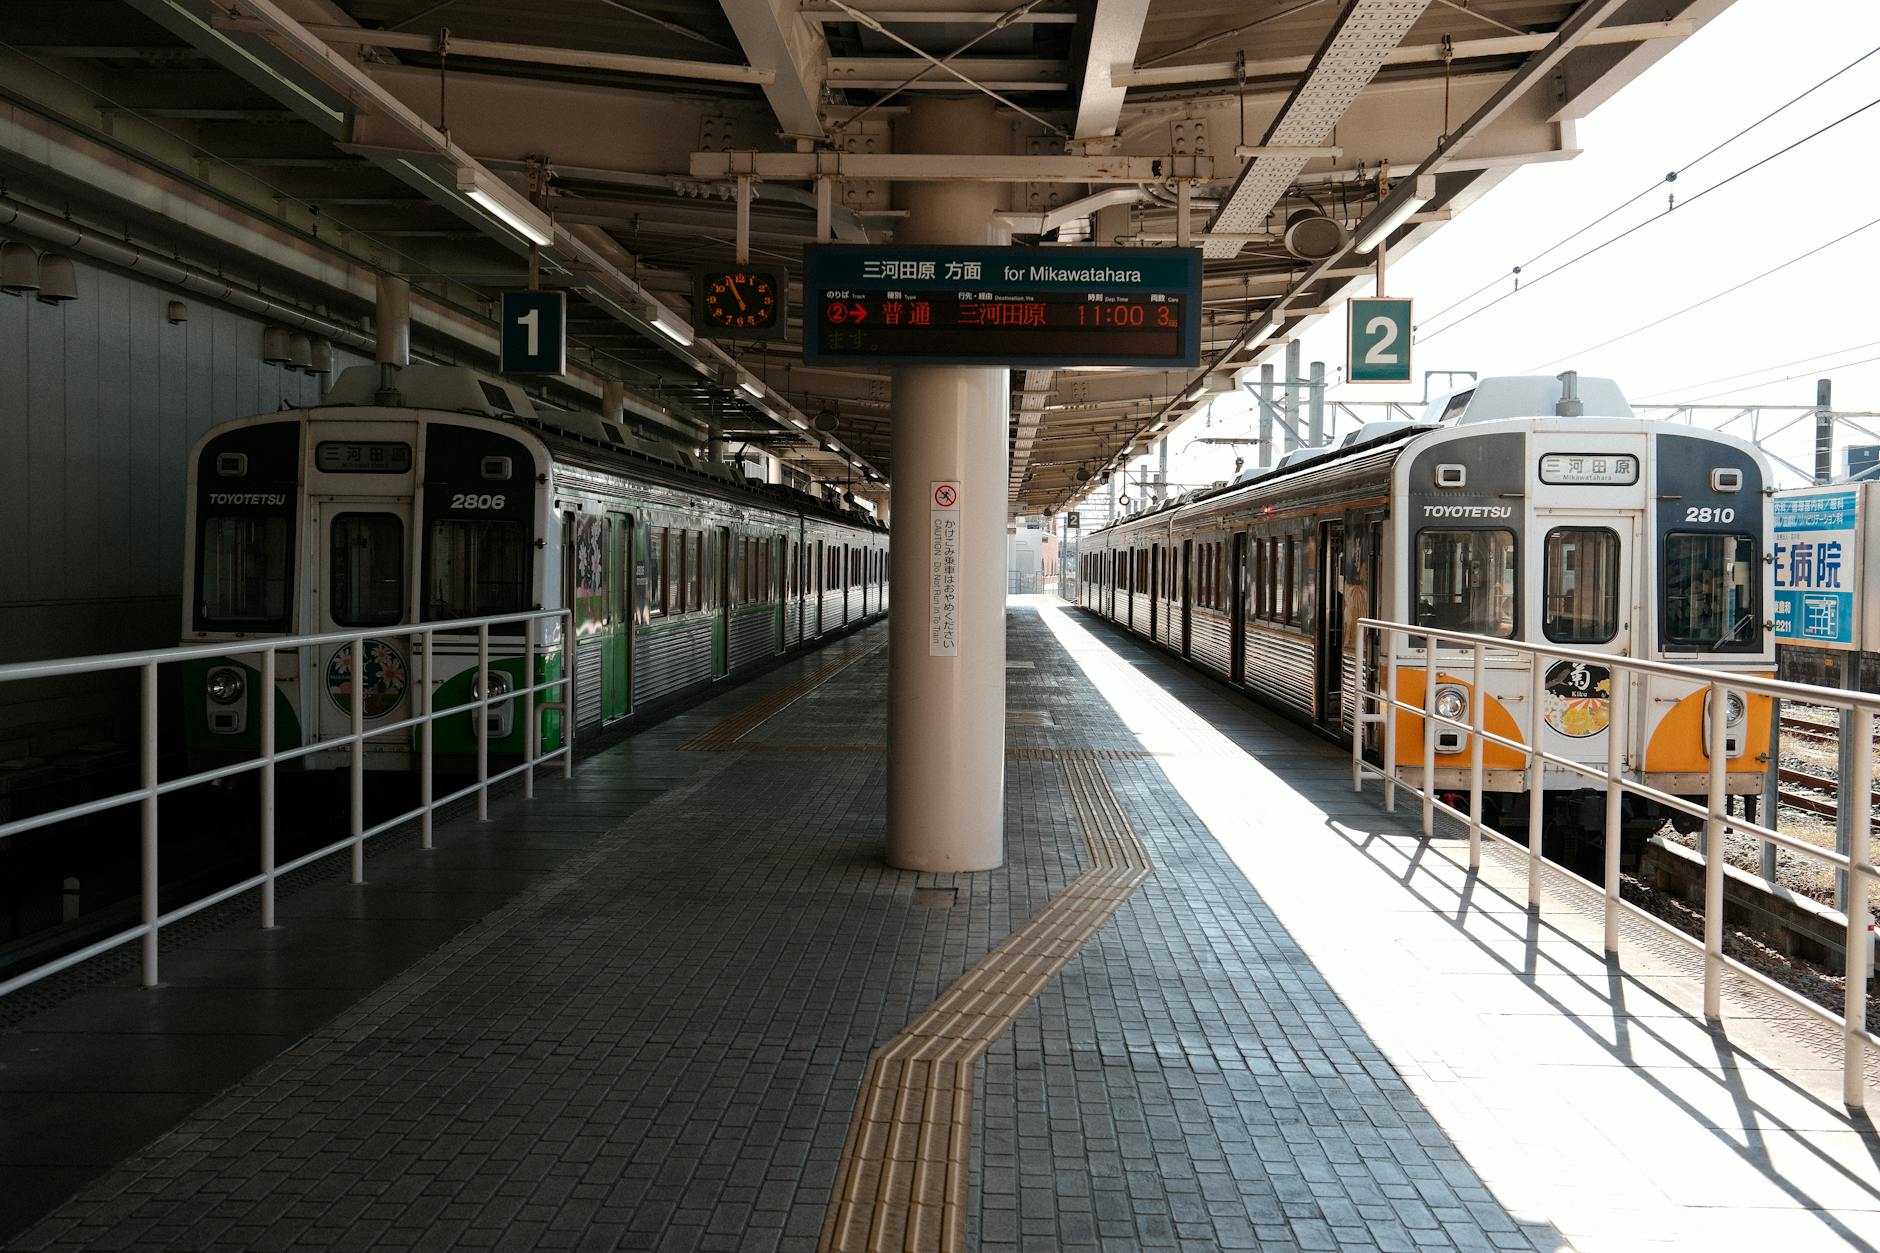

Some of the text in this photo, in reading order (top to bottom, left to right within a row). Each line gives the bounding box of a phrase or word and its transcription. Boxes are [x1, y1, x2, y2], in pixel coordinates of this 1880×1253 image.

[862, 260, 983, 281] 三河田原 方面
[1003, 265, 1142, 283] for Mikawatahara
[826, 290, 850, 300] のりば
[882, 301, 931, 325] 普通
[958, 302, 1047, 326] 三河田原
[1077, 305, 1145, 327] 11:00
[517, 309, 539, 356] 1
[1365, 316, 1398, 364] 2
[1545, 458, 1631, 475] 三河田原
[1562, 473, 1612, 481] Mikawatahara
[208, 493, 286, 505] TOYOTETSU
[450, 493, 506, 510] 2806
[1069, 514, 1078, 525] 2
[1423, 505, 1512, 518] TOYOTETSU
[1684, 506, 1735, 524] 2810
[934, 518, 942, 556] CAUTION
[943, 519, 955, 649] かけこみ乗車はおやめください
[1568, 662, 1591, 690] 菊
